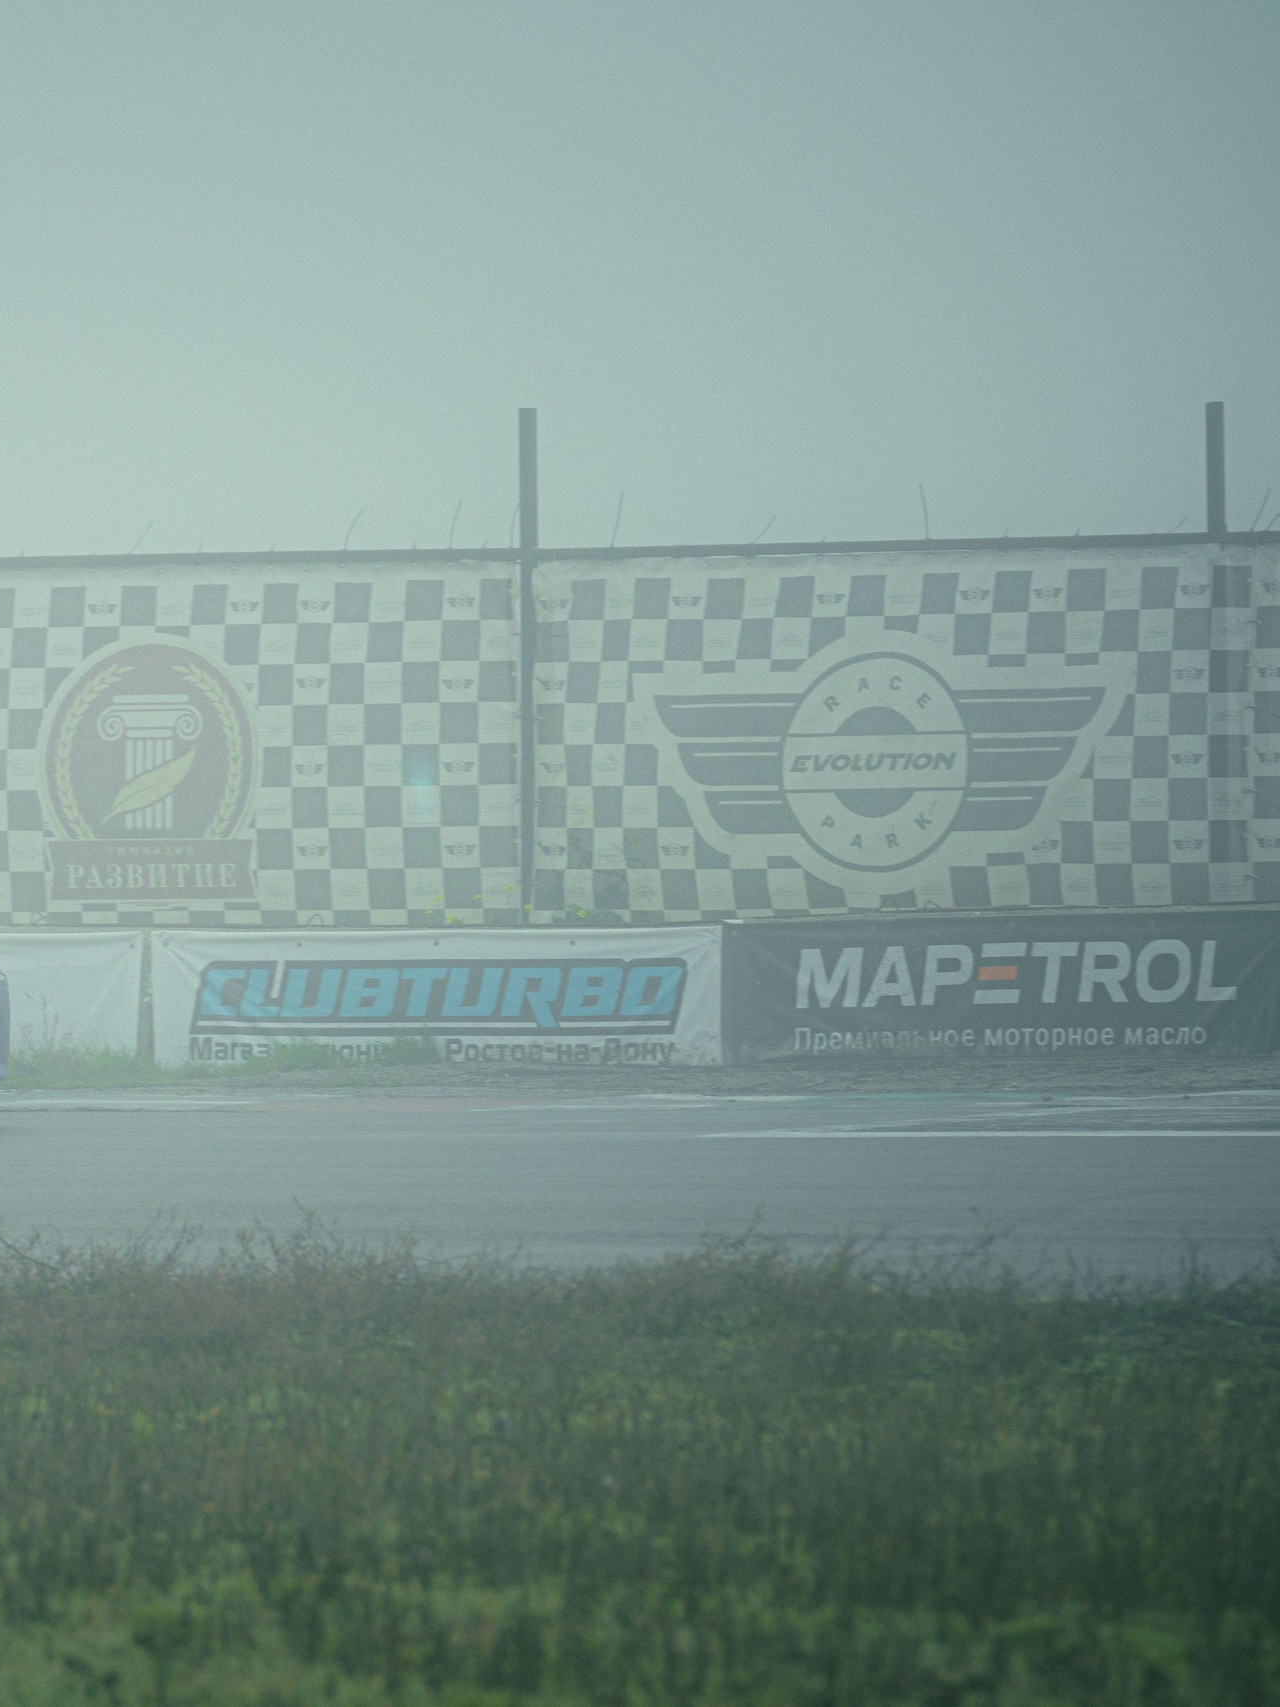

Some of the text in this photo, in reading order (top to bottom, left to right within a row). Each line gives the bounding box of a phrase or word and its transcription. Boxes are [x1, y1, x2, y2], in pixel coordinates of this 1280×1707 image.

[822, 675, 932, 713] RACE
[789, 751, 957, 773] EVOLUTION
[821, 812, 933, 850] PARK
[66, 862, 238, 890] РАЗВИТИЕ
[795, 938, 1238, 1009] MAPETROL
[202, 965, 685, 1028] CLUBTURBO
[984, 1026, 1115, 1051] моторное
[1124, 1026, 1207, 1047] масло
